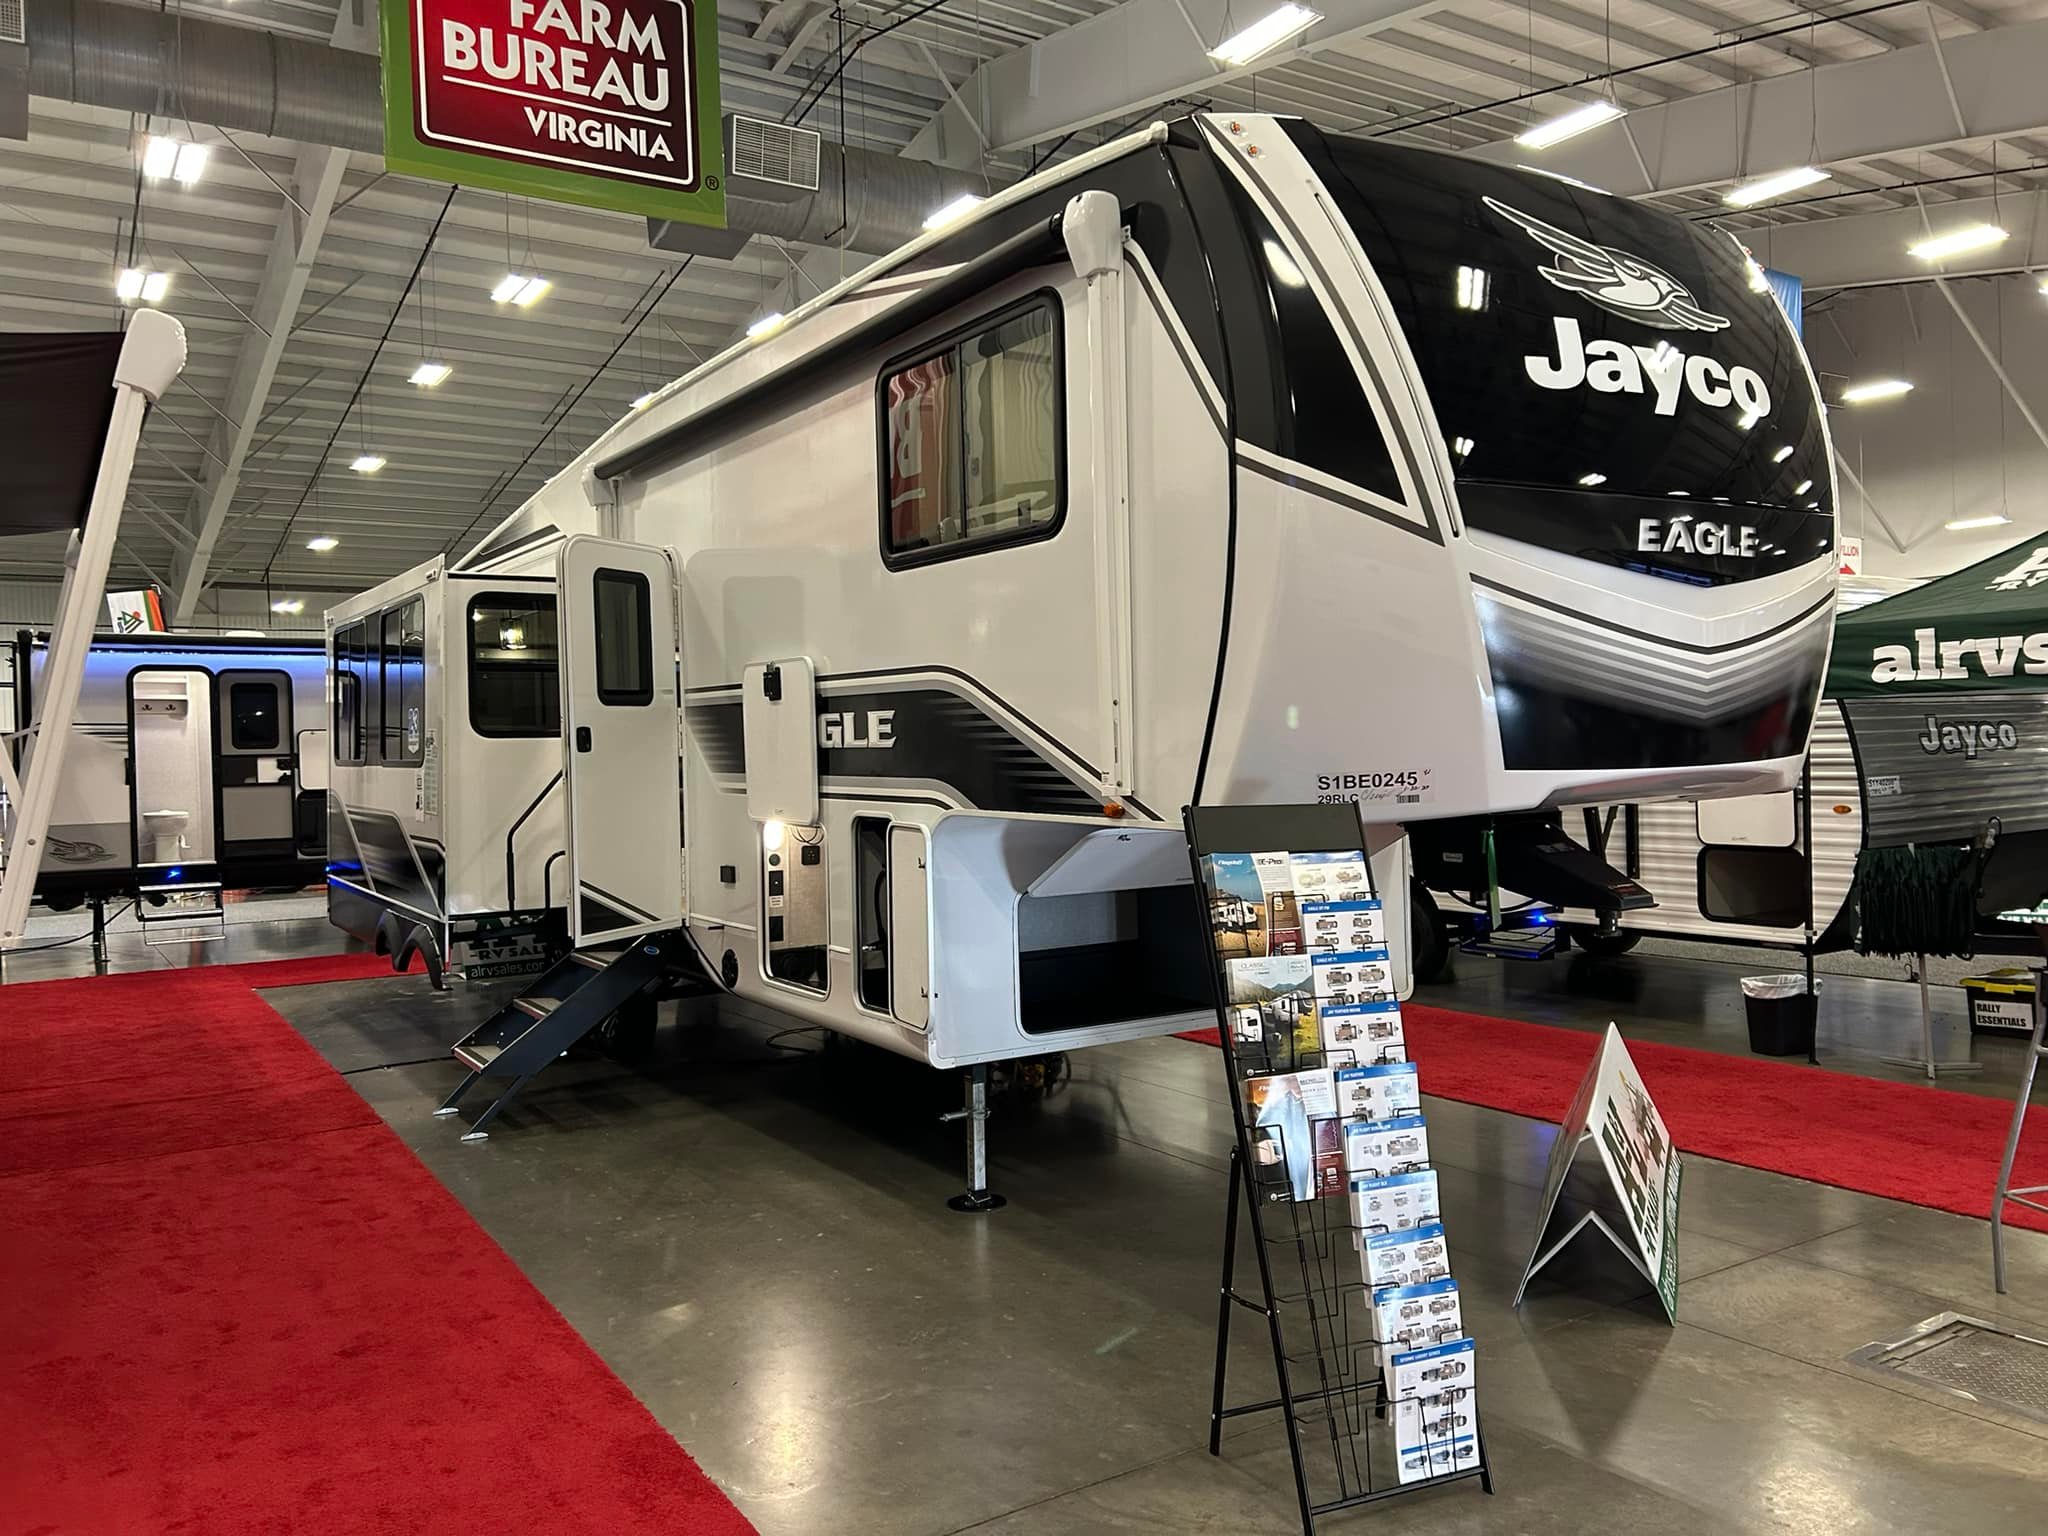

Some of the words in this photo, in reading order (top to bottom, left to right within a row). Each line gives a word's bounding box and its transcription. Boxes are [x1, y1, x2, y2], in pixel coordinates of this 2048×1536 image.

[509, 0, 665, 61] FARM
[441, 19, 670, 113] BUREAU
[524, 106, 675, 162] VIRGINIA
[1524, 316, 1771, 416] Jayco
[1637, 518, 1759, 558] EAGLE
[818, 709, 897, 748] GLE
[1919, 713, 2018, 760] Jayco
[1317, 771, 1418, 790] S1BE0245
[1976, 1003, 2000, 1013] RALLY
[1977, 1014, 2027, 1027] ESSENTIALS
